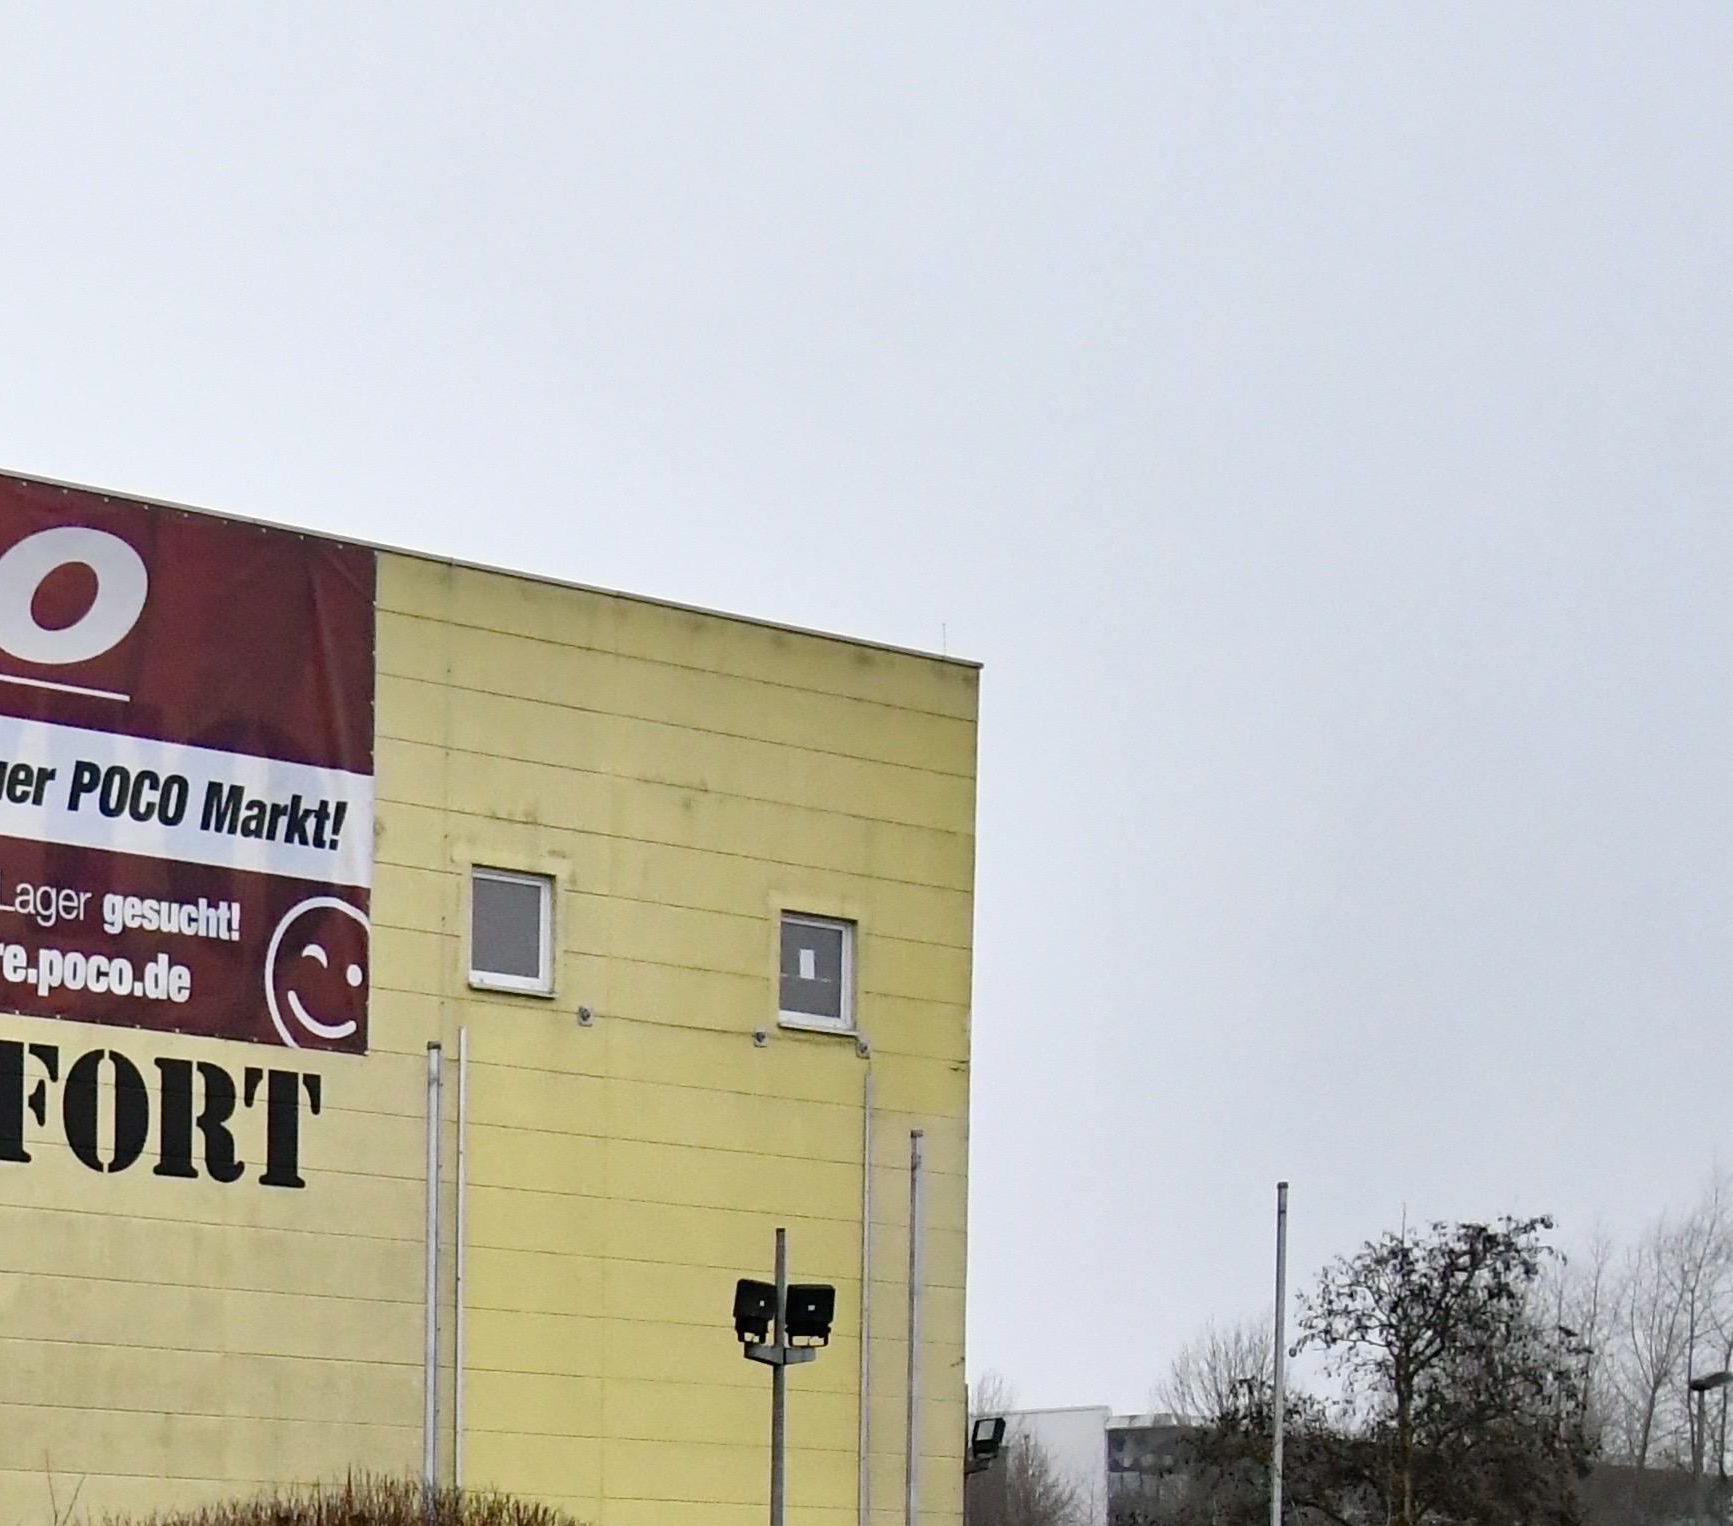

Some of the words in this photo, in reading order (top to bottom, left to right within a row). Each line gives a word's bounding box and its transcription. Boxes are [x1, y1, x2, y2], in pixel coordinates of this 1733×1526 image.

[68, 761, 189, 828] POCO
[201, 781, 348, 850] Markt!
[103, 893, 241, 940] gesucht!
